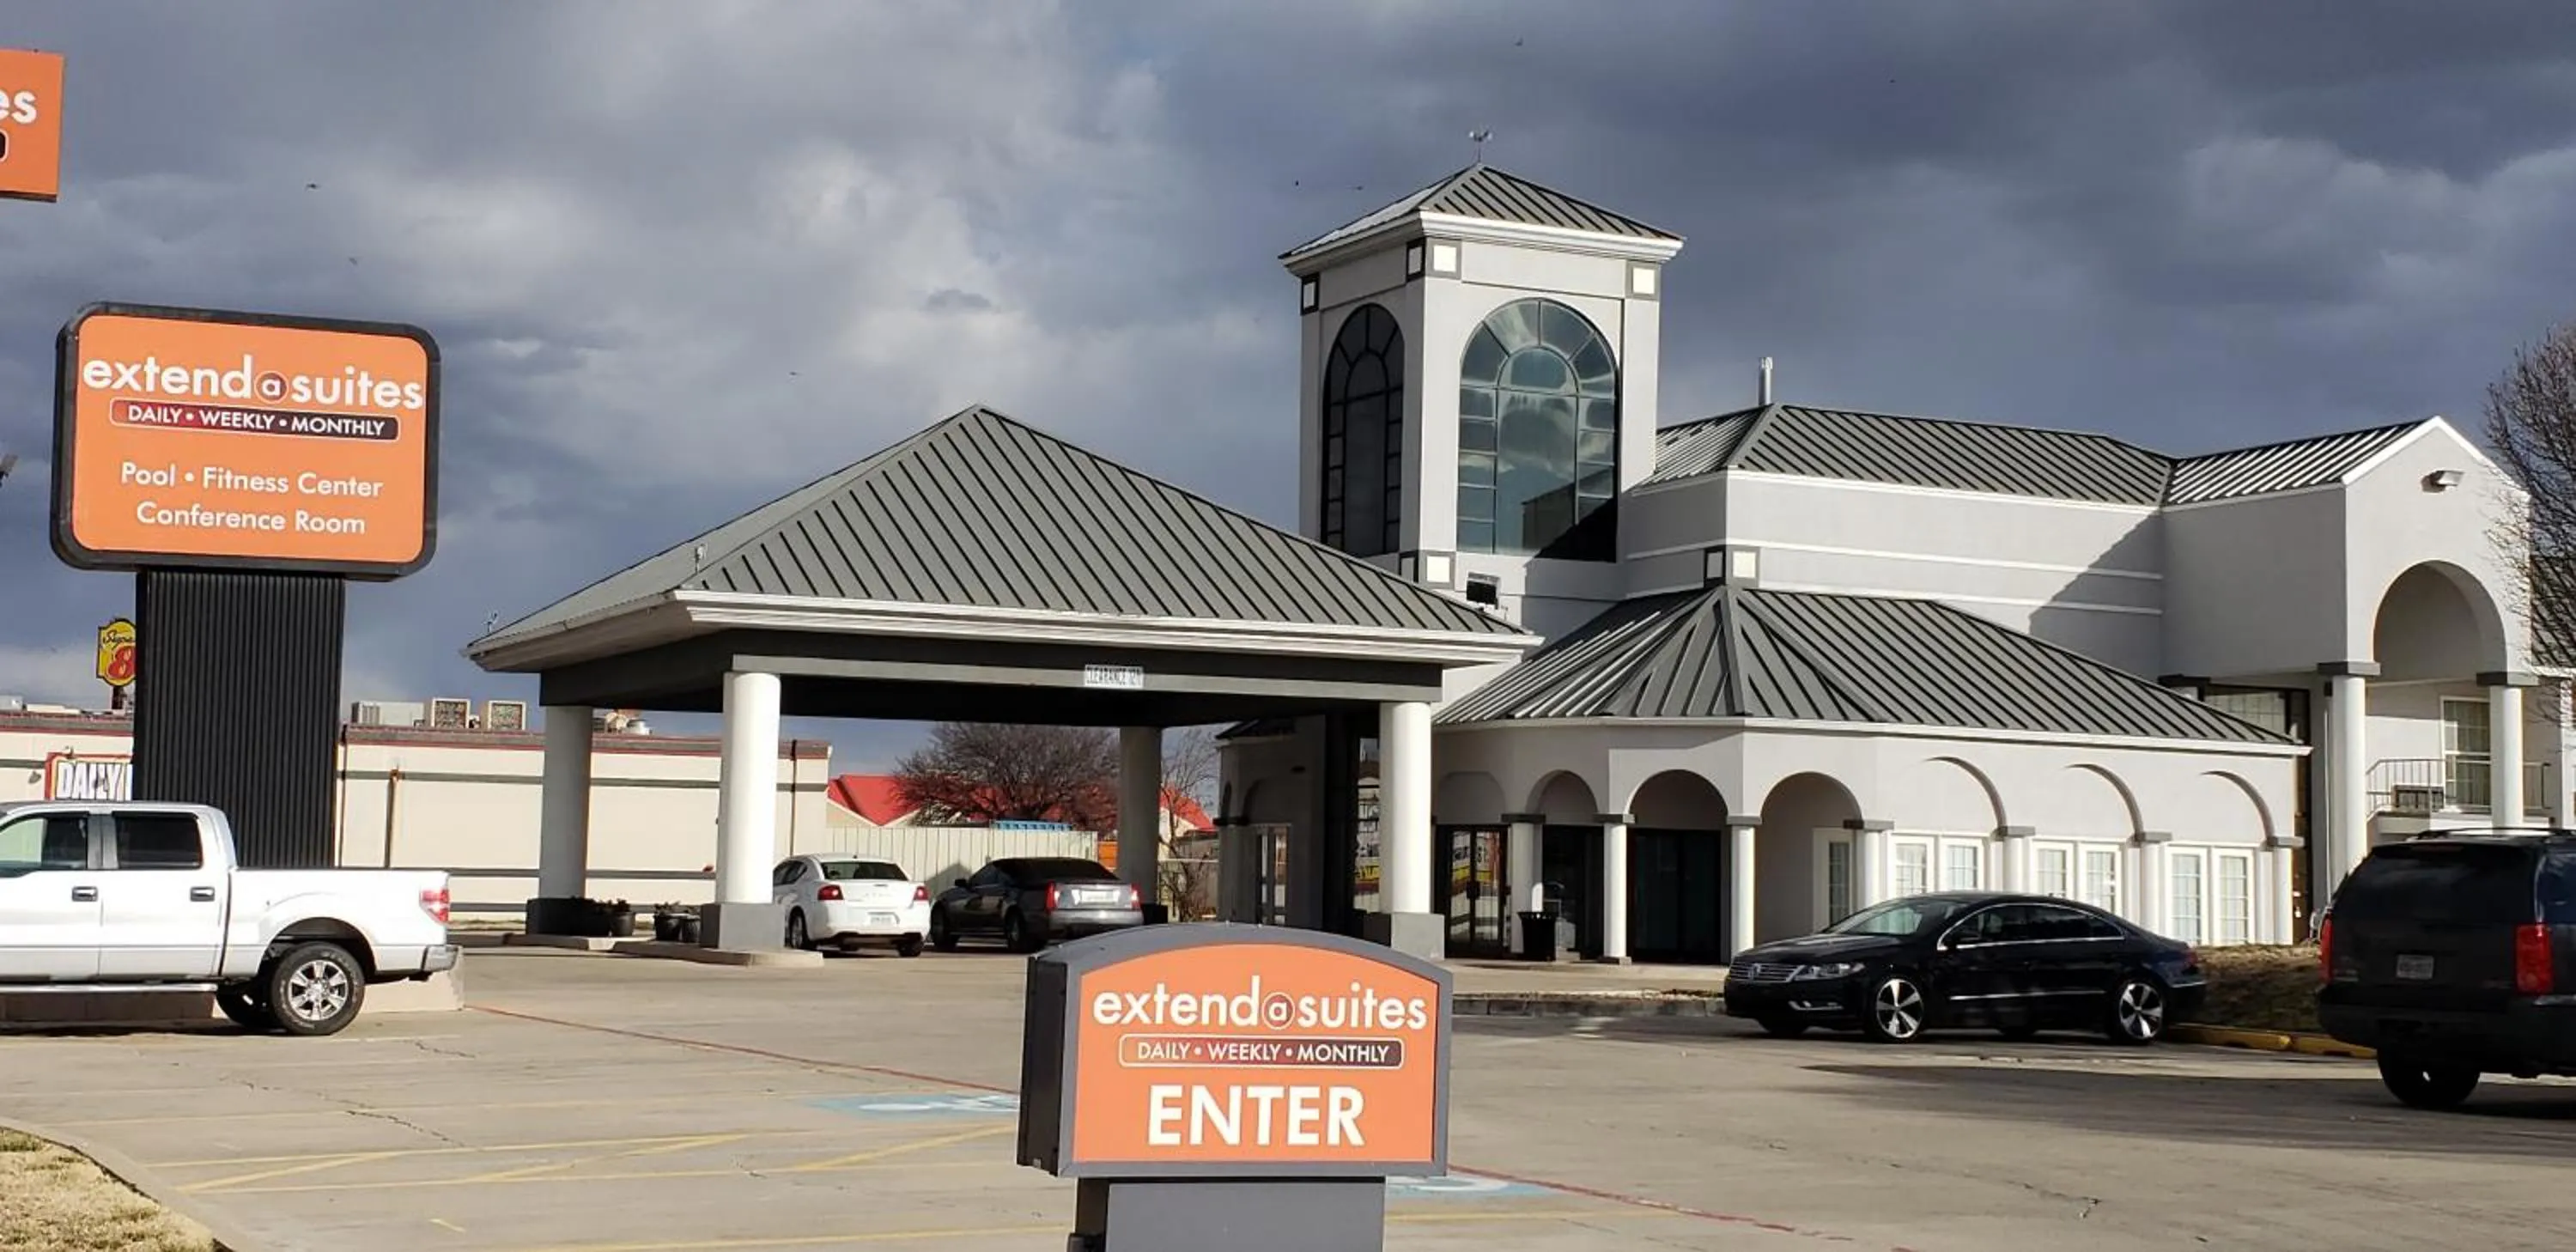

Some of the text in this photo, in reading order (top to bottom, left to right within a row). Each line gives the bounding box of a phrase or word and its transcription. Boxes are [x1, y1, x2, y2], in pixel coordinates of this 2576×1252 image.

[128, 404, 386, 436] DAILY WEEKLY MONTHLY
[121, 461, 384, 497] Pool Fitness Center
[137, 501, 366, 534] Conference Room
[107, 646, 136, 679] 8
[57, 762, 120, 800] DAILY
[1138, 1042, 1389, 1063] DAILY WEEKLY MONTHLY
[1148, 1085, 1365, 1146] ENTER
